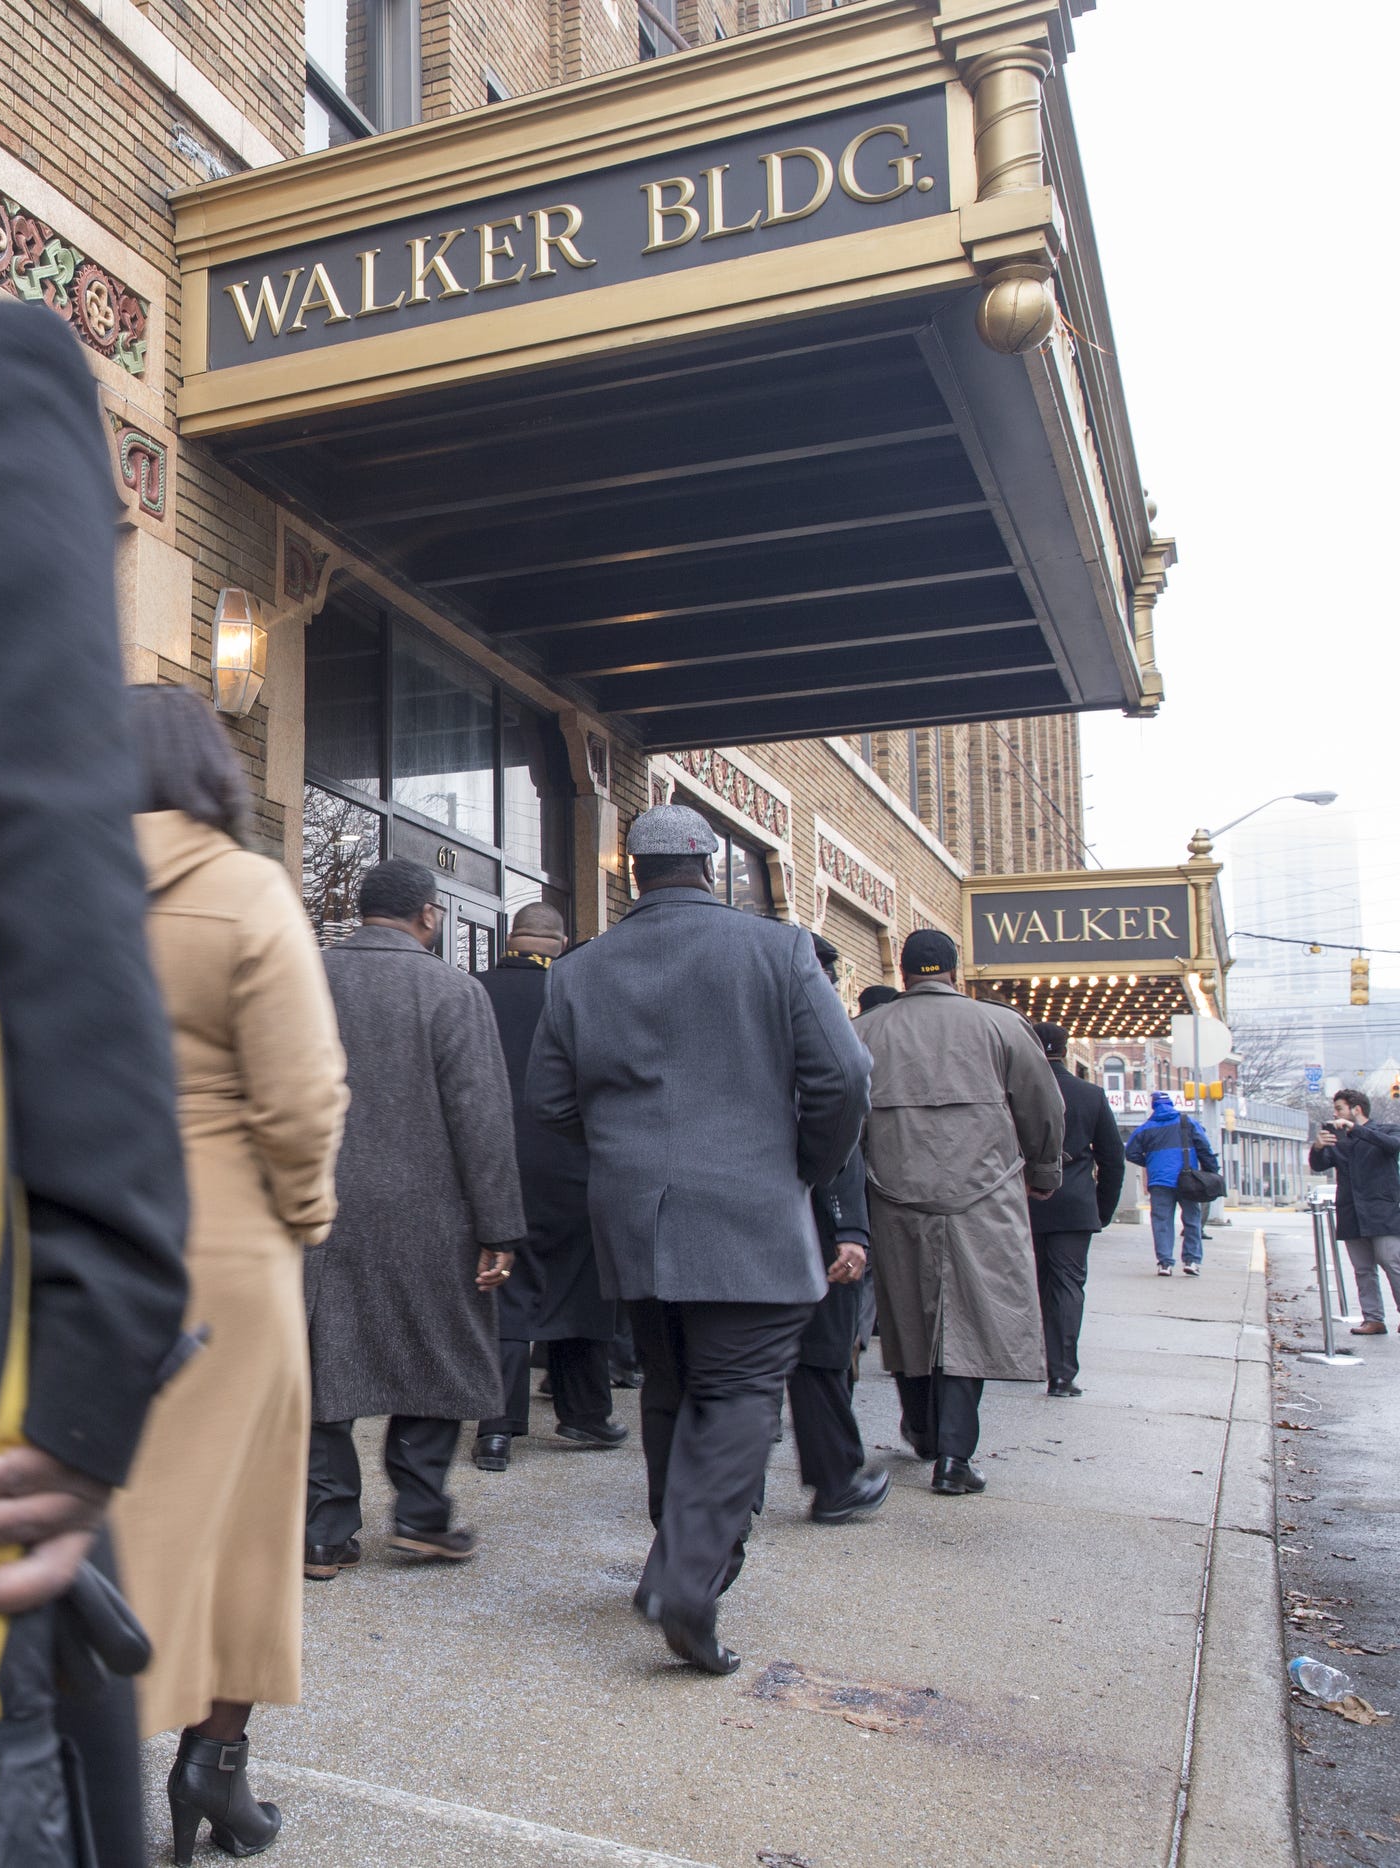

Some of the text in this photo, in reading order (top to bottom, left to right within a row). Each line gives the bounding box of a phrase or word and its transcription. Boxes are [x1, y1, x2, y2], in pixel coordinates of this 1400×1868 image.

[223, 123, 935, 343] WALKER BLDG.
[437, 846, 457, 872] 617
[983, 906, 1180, 944] WALKER
